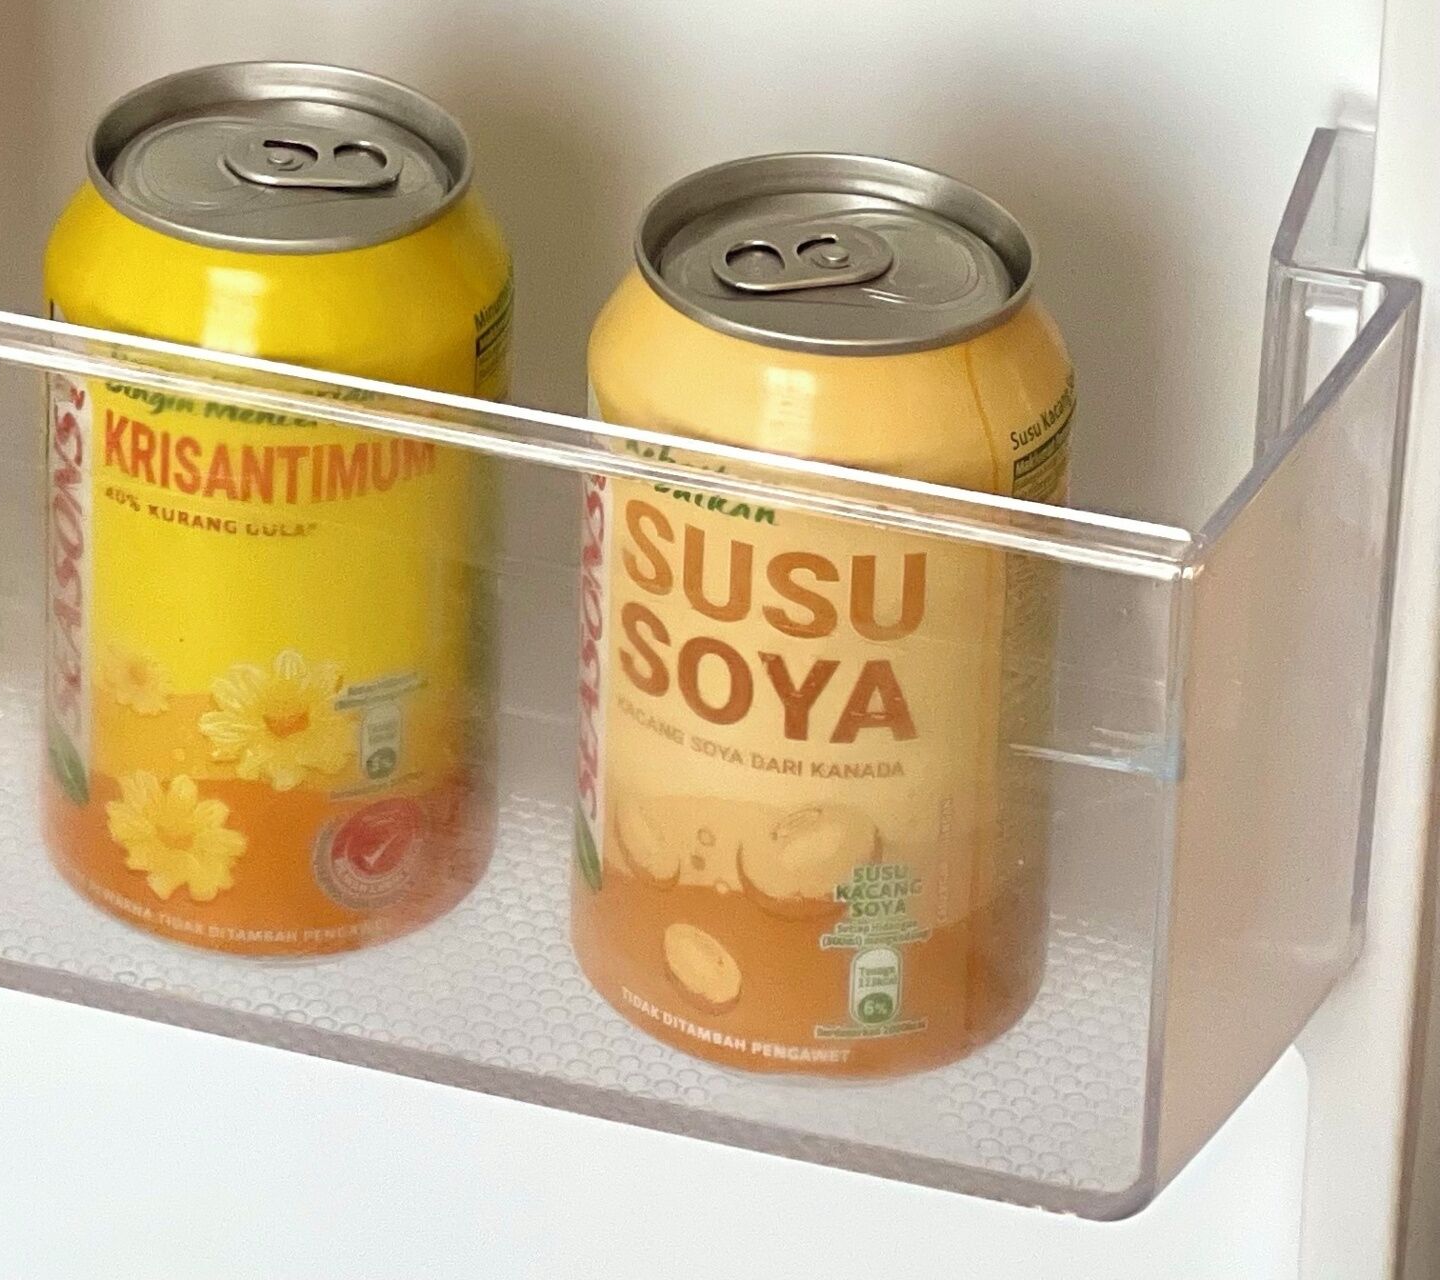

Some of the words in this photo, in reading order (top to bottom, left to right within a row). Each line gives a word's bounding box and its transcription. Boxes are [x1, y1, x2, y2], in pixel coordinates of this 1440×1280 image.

[104, 409, 437, 505] KRISANTIMUM
[1010, 421, 1042, 451] Susu
[148, 504, 238, 536] KURANG
[622, 499, 927, 641] SUSU
[619, 601, 919, 744] SOYA
[690, 736, 745, 766] SOYA
[751, 753, 803, 776] DARI
[811, 761, 905, 780] KANADA
[852, 899, 906, 917] SOYA
[622, 986, 660, 1021] TIDAK
[662, 1010, 746, 1052] DITAMBAH
[751, 1041, 851, 1064] PENGAWET
